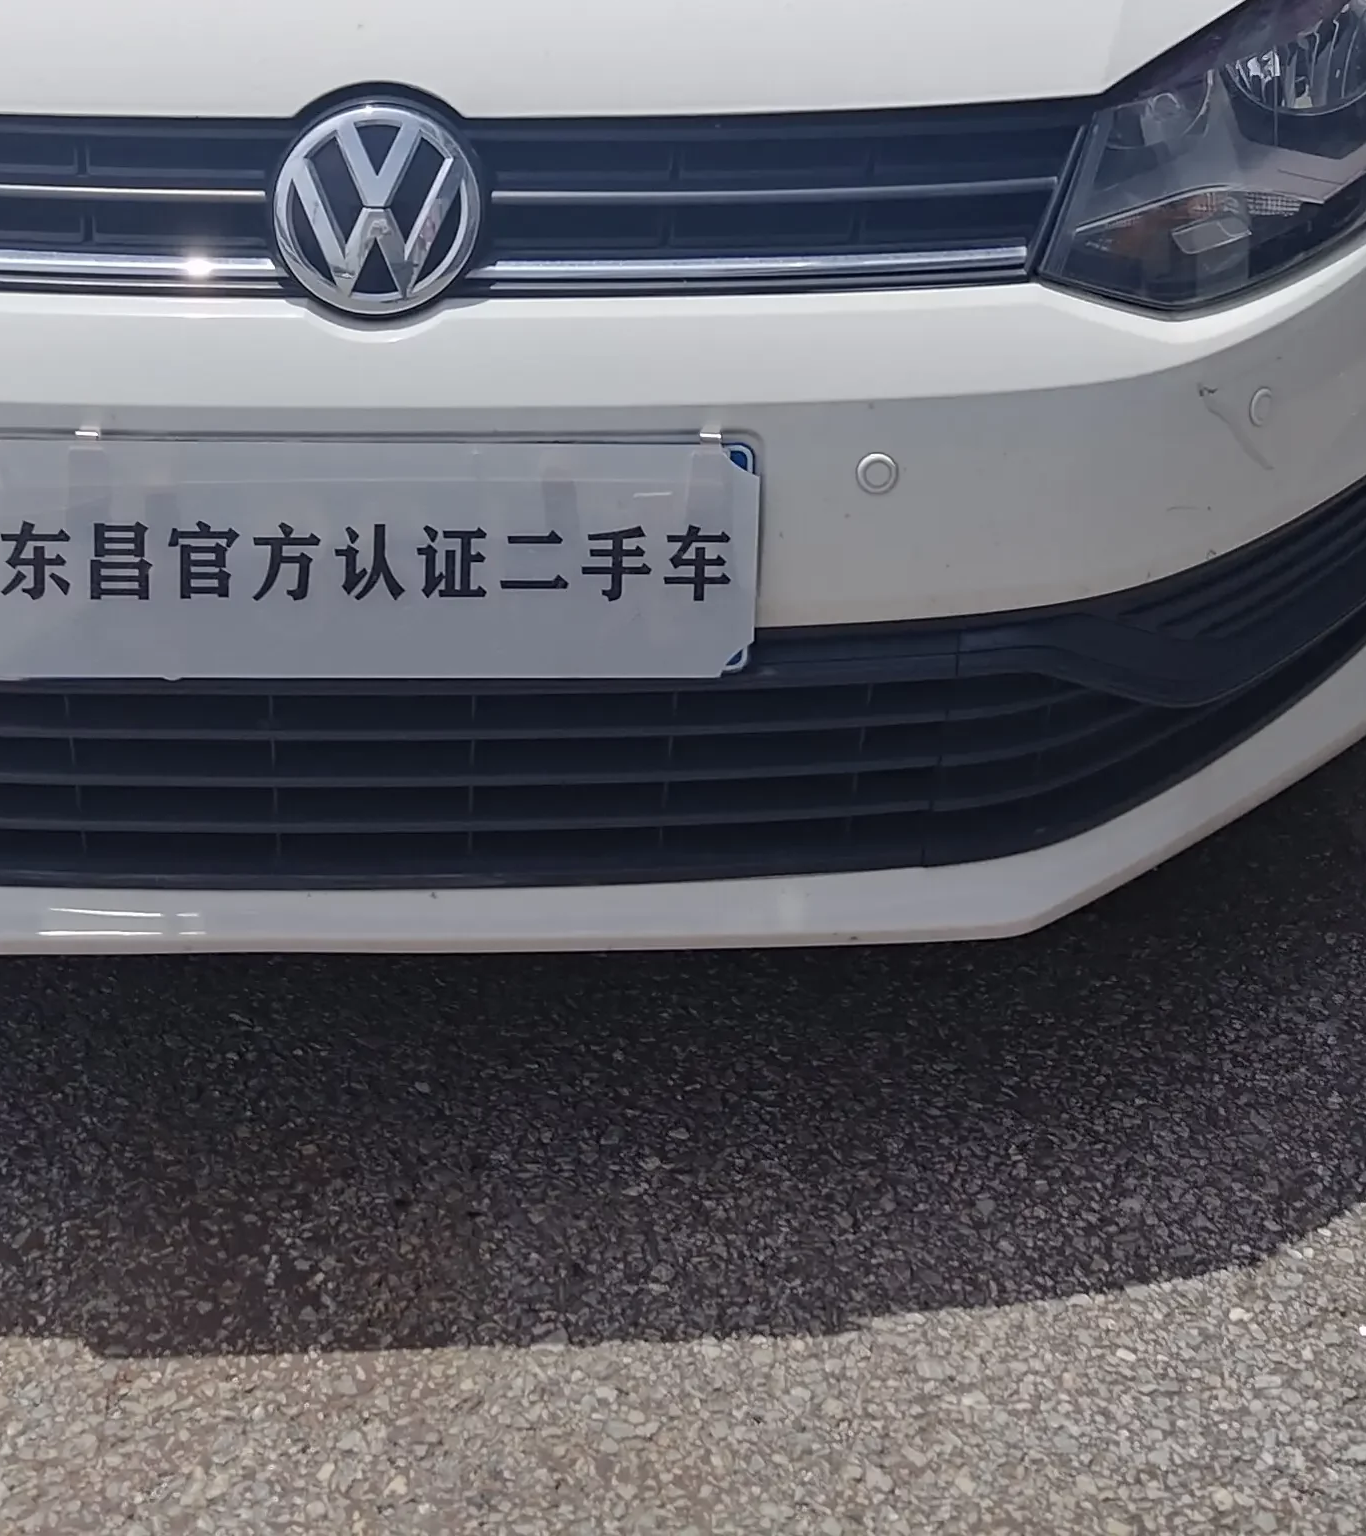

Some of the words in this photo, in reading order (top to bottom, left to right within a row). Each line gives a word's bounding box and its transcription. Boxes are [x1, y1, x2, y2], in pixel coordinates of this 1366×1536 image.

[0, 522, 732, 603] 东昌官方认证二手车
